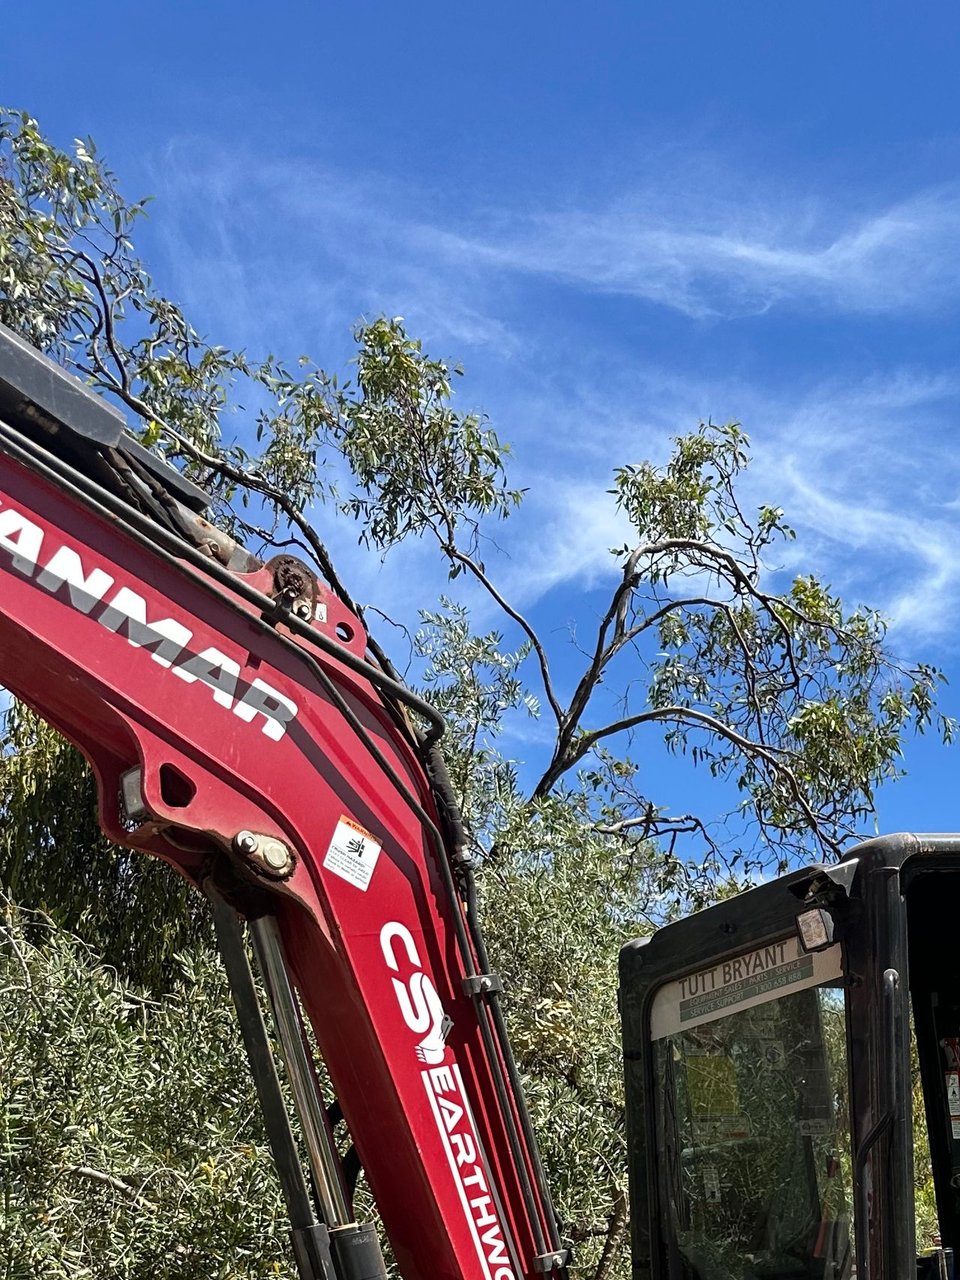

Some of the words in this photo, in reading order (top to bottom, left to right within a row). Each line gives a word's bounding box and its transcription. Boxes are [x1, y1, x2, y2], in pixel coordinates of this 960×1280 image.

[0, 501, 299, 743] ANMAR
[678, 968, 718, 999] TUTT
[722, 941, 788, 985] BRYANT
[723, 982, 743, 995] SALES
[775, 960, 801, 976] SERVICE
[689, 1002, 715, 1018] SERVICE
[716, 991, 745, 1009] SUPPORT
